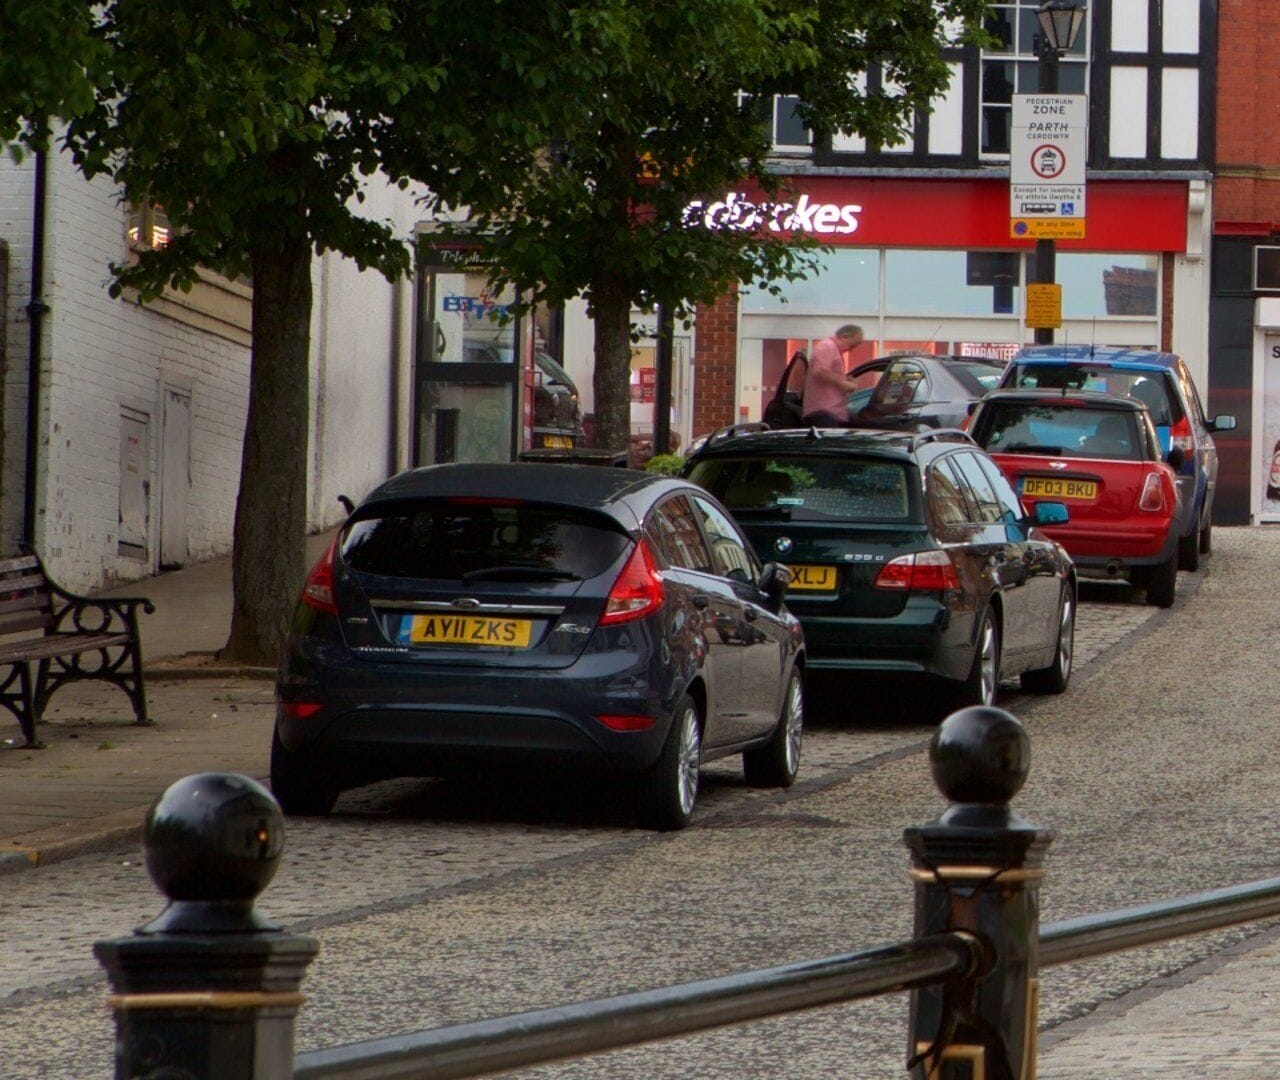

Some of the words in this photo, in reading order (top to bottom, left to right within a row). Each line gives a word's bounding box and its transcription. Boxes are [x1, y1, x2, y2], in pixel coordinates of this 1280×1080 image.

[1033, 106, 1066, 115] ZONE
[1028, 122, 1069, 132] PARTH
[1026, 480, 1062, 495] DF03
[1067, 482, 1094, 497] BKU
[790, 567, 828, 585] XLJ
[423, 618, 467, 638] AY11
[474, 621, 517, 642] ZKS
